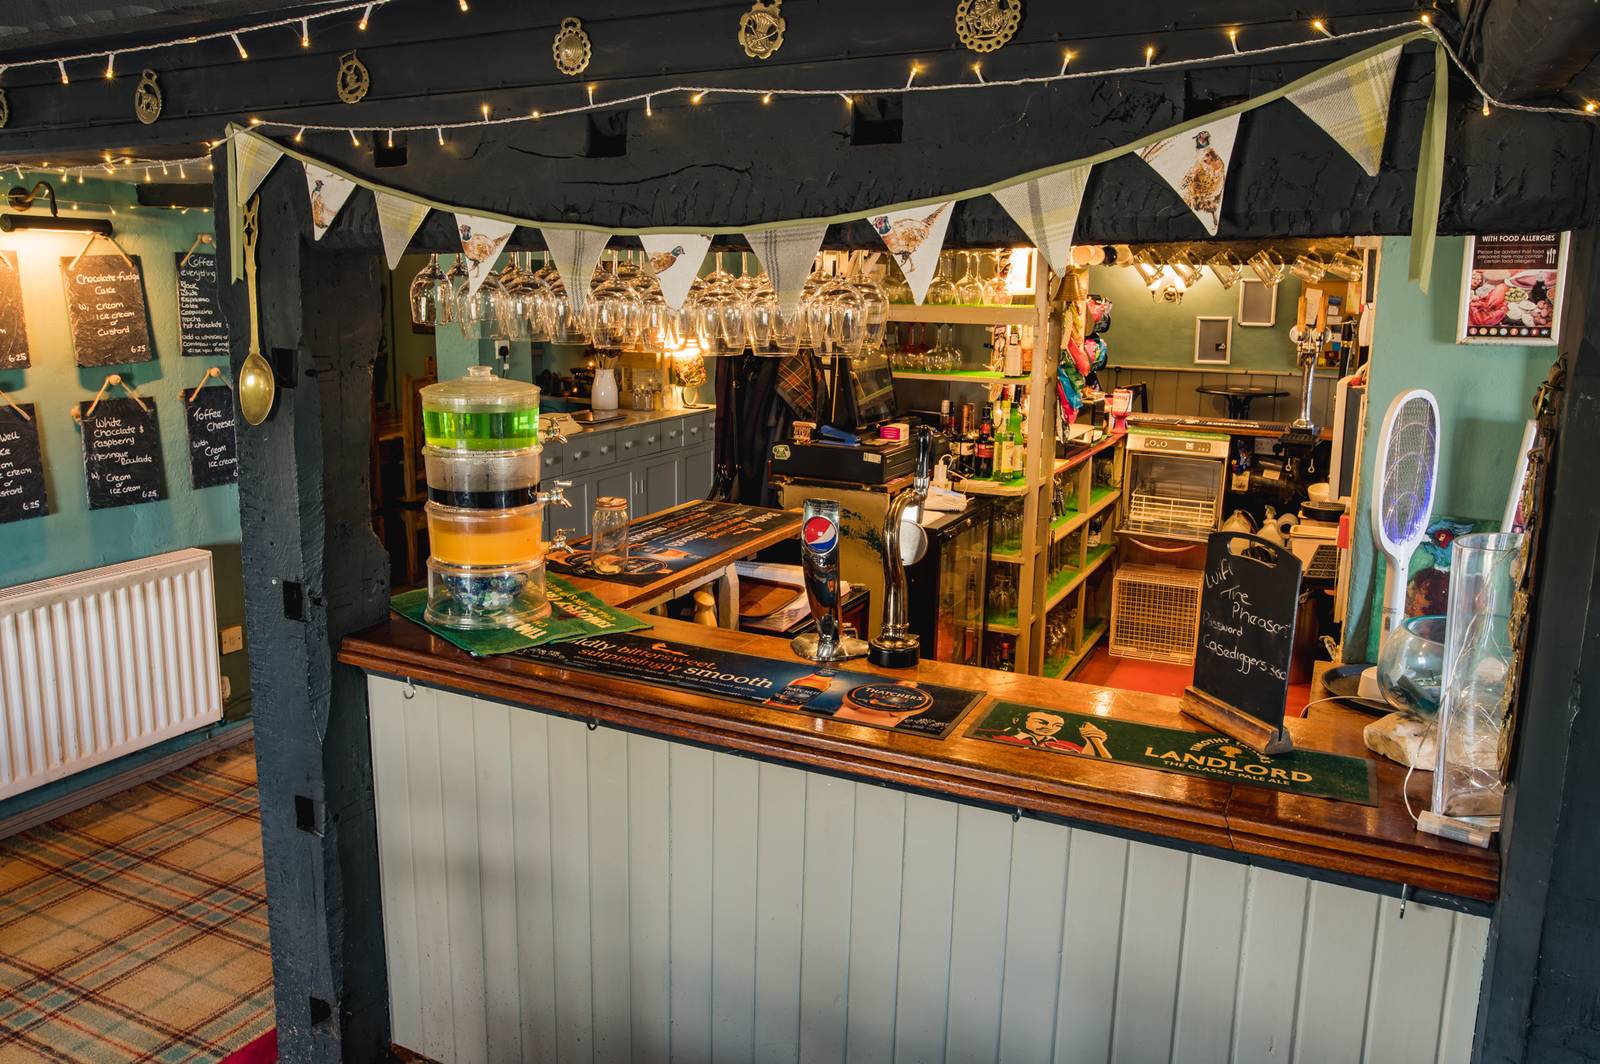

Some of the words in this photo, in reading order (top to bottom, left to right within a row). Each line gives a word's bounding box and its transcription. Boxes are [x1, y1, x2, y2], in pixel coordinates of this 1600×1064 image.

[1520, 234, 1555, 242] ALLERGIES
[188, 254, 214, 268] Coffee
[76, 273, 116, 285] Chocolate
[180, 270, 216, 283] everything
[94, 286, 116, 295] Cake
[97, 325, 130, 336] Custard
[194, 320, 222, 329] chocolate
[193, 407, 222, 422] Toffee
[95, 416, 122, 428] White
[206, 418, 235, 432] Cheesec
[94, 425, 136, 438] Chocolate
[93, 436, 136, 449] raspberry
[3, 480, 14, 488] or
[1220, 584, 1253, 606] The
[1202, 610, 1244, 638] Password
[617, 644, 718, 670] bittersweet,
[577, 648, 682, 672] surprisingly
[683, 666, 774, 690] smooth
[865, 687, 924, 702] THATCHERS
[1144, 746, 1313, 783] LANDLORD
[1163, 760, 1184, 768] THE
[1187, 763, 1236, 777] CLASSIC
[1238, 772, 1266, 784] PALE
[1267, 778, 1291, 786] ALE
